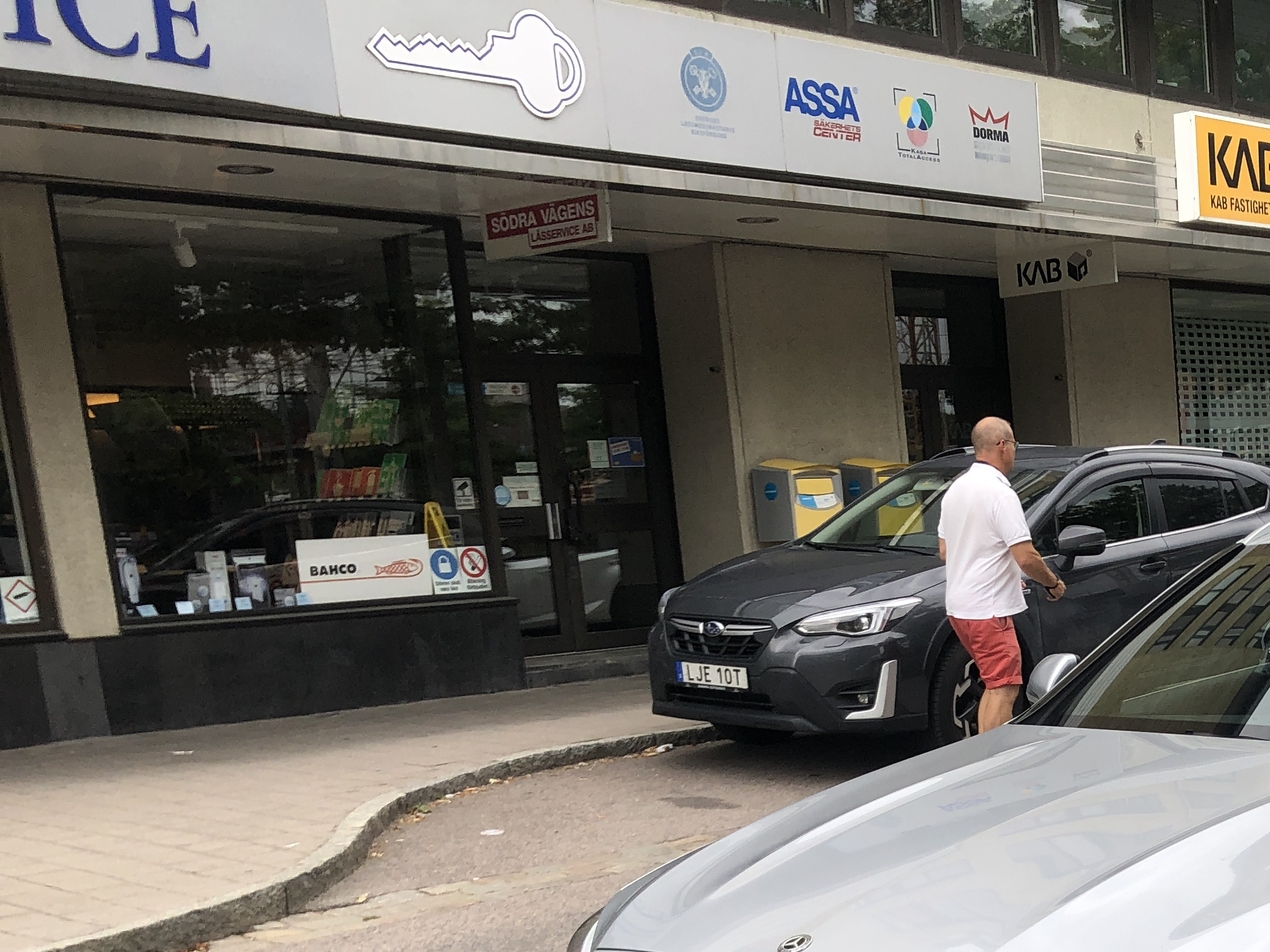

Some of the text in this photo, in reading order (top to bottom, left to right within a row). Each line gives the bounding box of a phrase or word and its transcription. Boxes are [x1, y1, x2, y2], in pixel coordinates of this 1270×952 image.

[784, 77, 860, 122] ASSA
[813, 119, 861, 132] SÄKERHETS
[813, 127, 861, 142] CENTER
[973, 127, 1010, 142] DORMA
[1210, 194, 1228, 210] KAB
[491, 199, 595, 234] SÖDRA VÄGENS
[530, 222, 594, 243] LÅSSERVICE AB
[1016, 257, 1062, 287] KAB
[310, 563, 357, 577] BAHCO
[686, 664, 740, 686] LJE 10T
